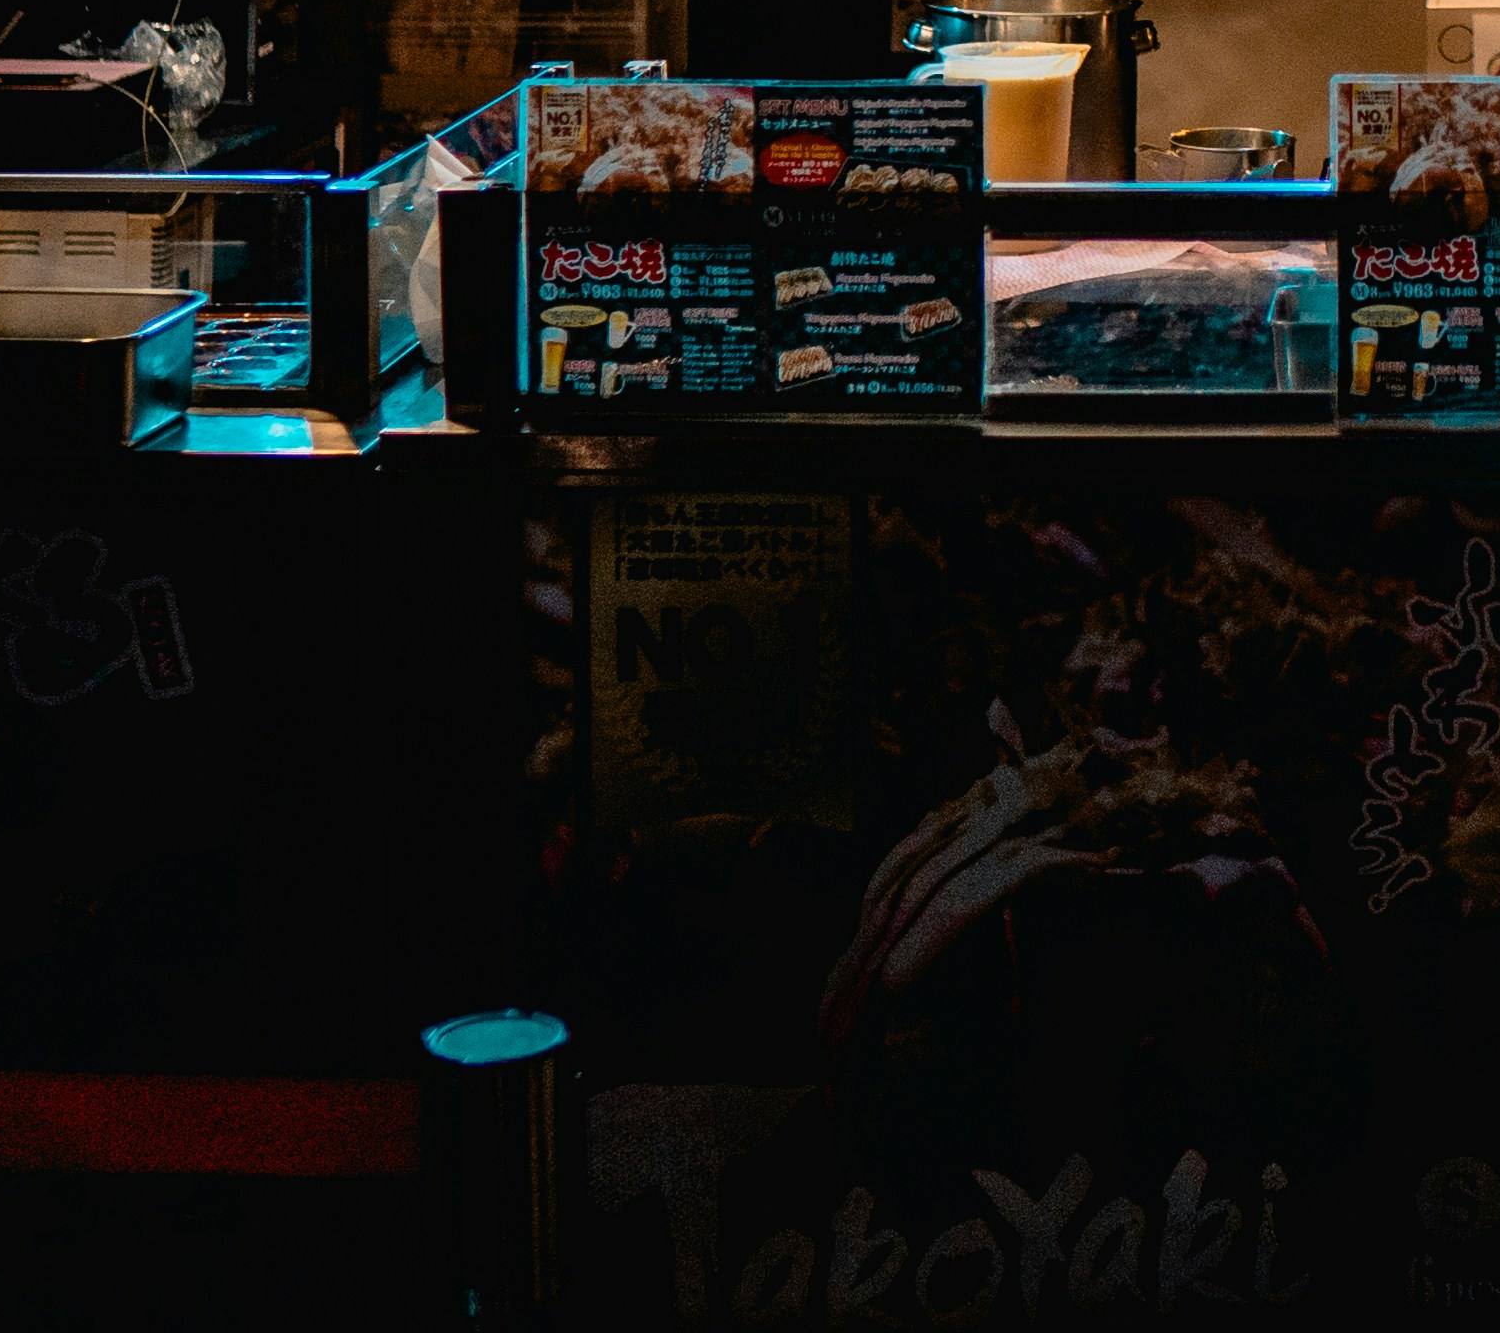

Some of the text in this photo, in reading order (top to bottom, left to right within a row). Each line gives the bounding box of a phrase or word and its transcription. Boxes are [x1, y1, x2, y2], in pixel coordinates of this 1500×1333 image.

[540, 237, 667, 284] たこ焼
[1351, 235, 1481, 282] たこ焼
